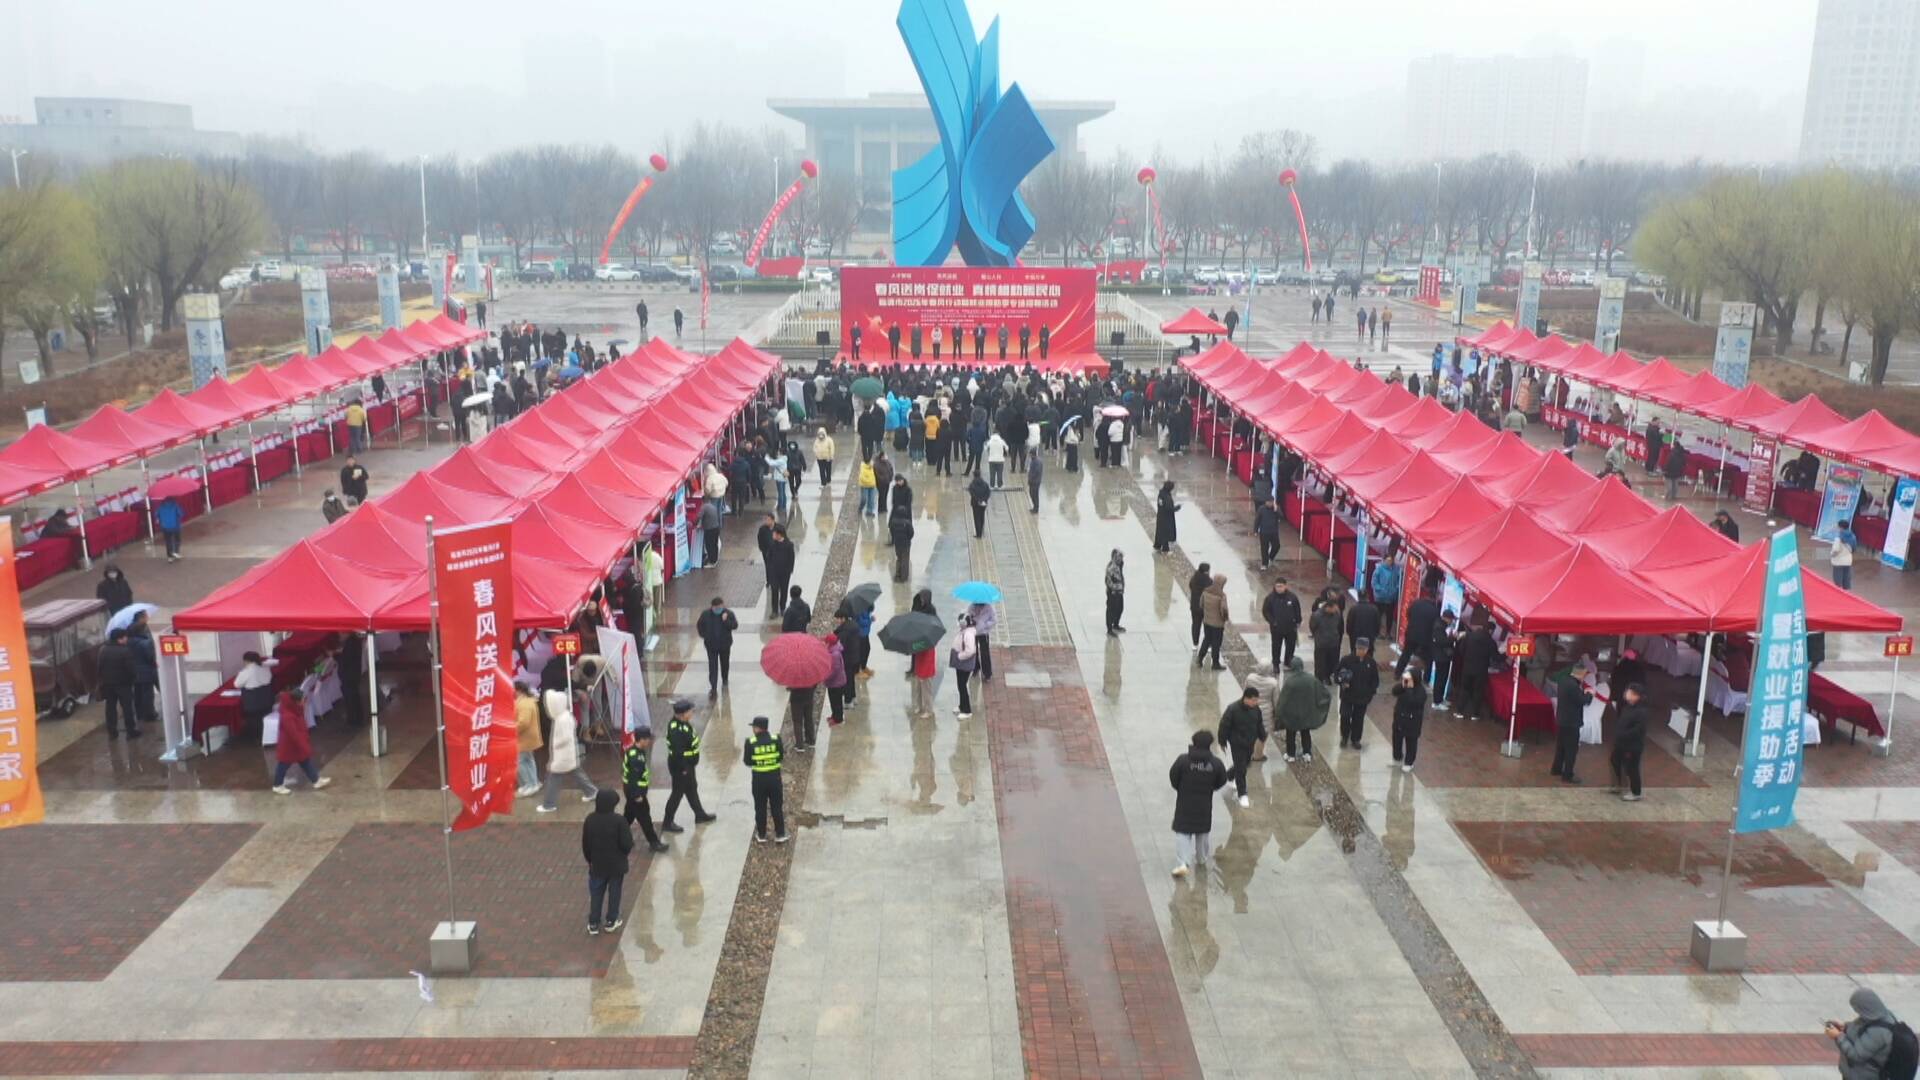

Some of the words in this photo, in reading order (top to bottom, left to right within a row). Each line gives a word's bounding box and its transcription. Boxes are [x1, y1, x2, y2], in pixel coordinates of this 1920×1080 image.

[556, 640, 576, 652] C区
[1510, 643, 1529, 655] D区
[469, 579, 498, 792] 春风送岗促就业
